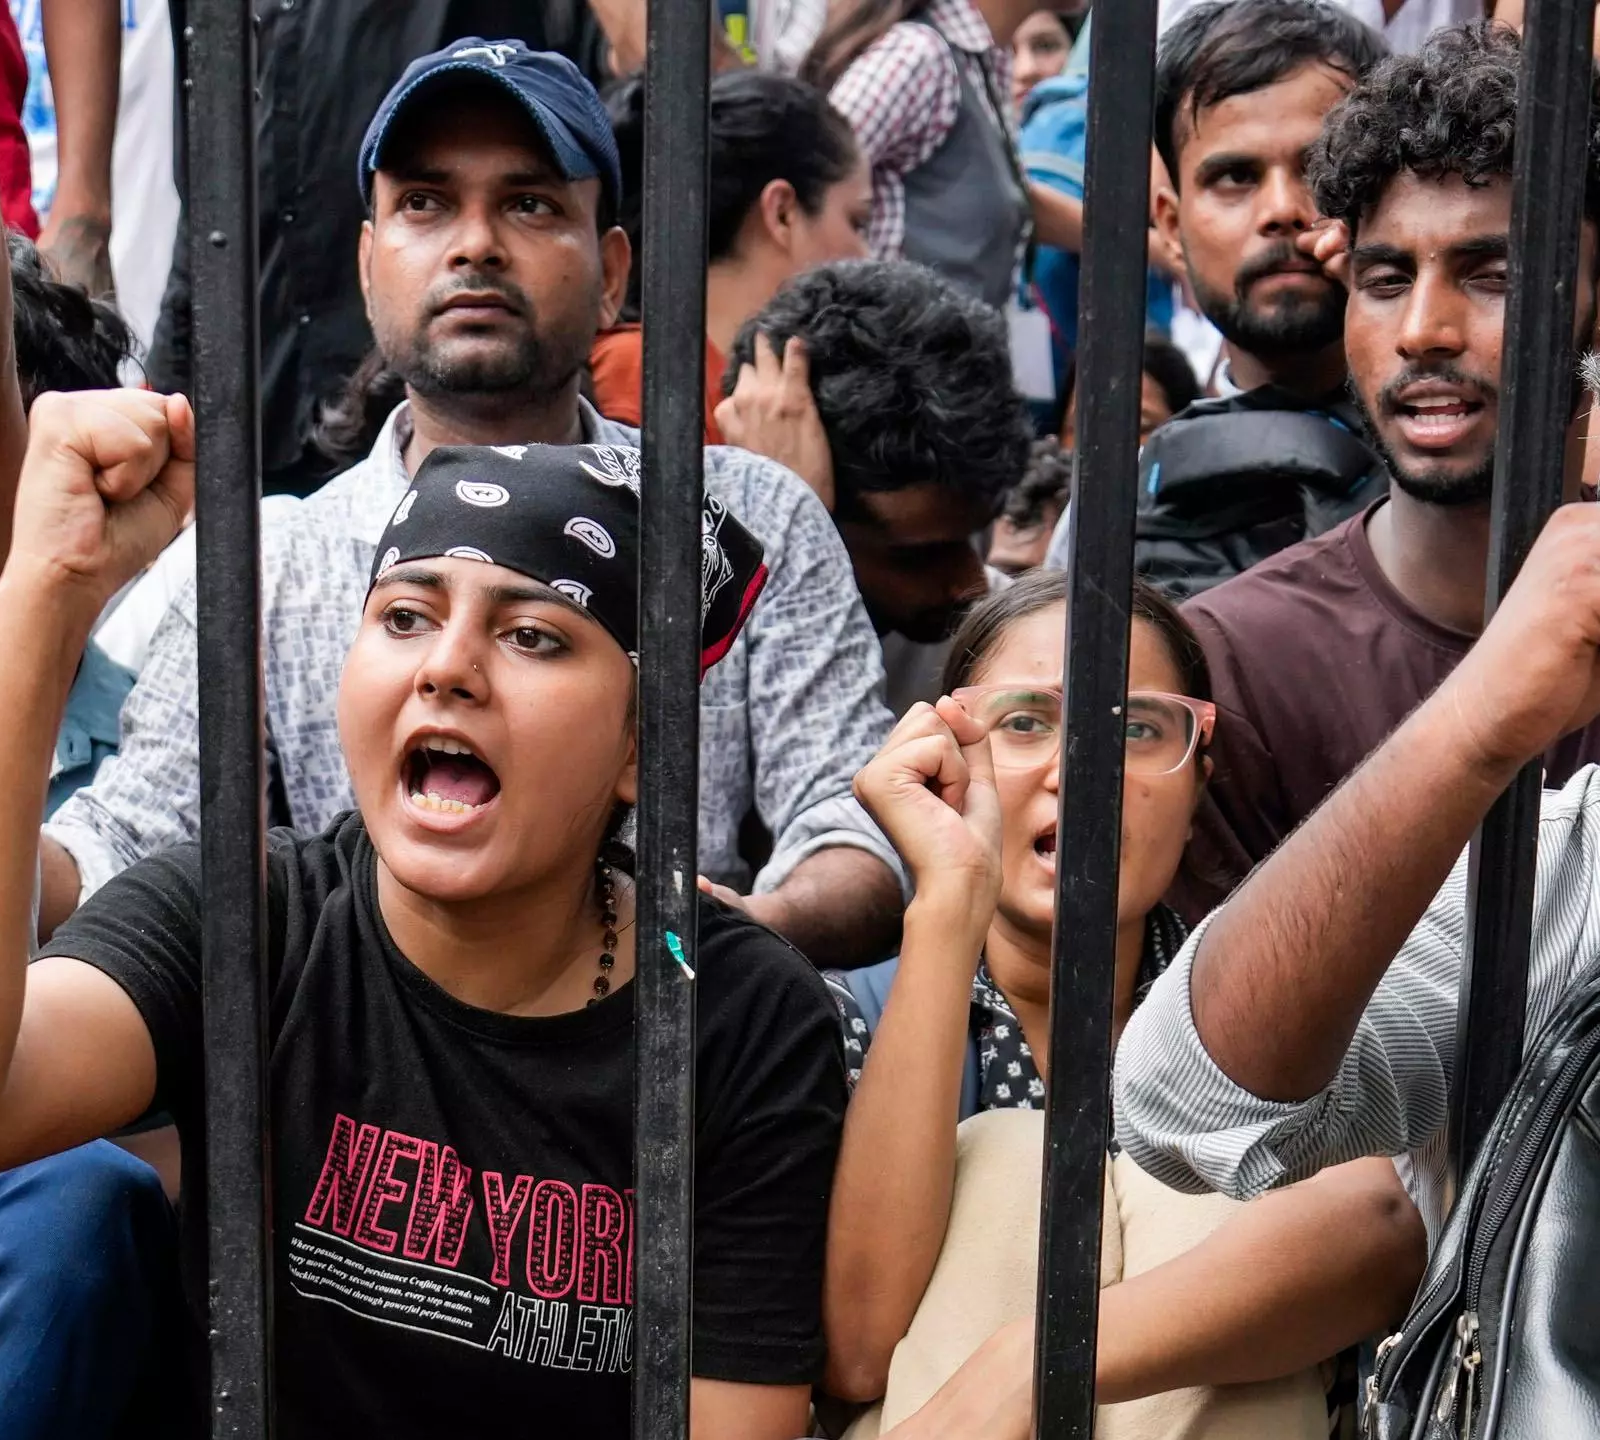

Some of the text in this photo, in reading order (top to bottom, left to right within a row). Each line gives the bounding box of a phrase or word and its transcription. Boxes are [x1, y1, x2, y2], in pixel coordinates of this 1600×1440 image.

[304, 1113, 634, 1304] NEW YOR
[290, 1236, 491, 1306] Where passion meets persistance Crafting legends with
[305, 1259, 327, 1269] move
[327, 1263, 349, 1280] Every
[348, 1274, 376, 1289] second
[404, 1290, 427, 1303] every
[426, 1296, 444, 1307] step
[443, 1300, 473, 1314] matters
[319, 1276, 353, 1295] potential
[352, 1289, 384, 1306] through
[383, 1300, 421, 1315] powerful
[418, 1308, 474, 1329] performances
